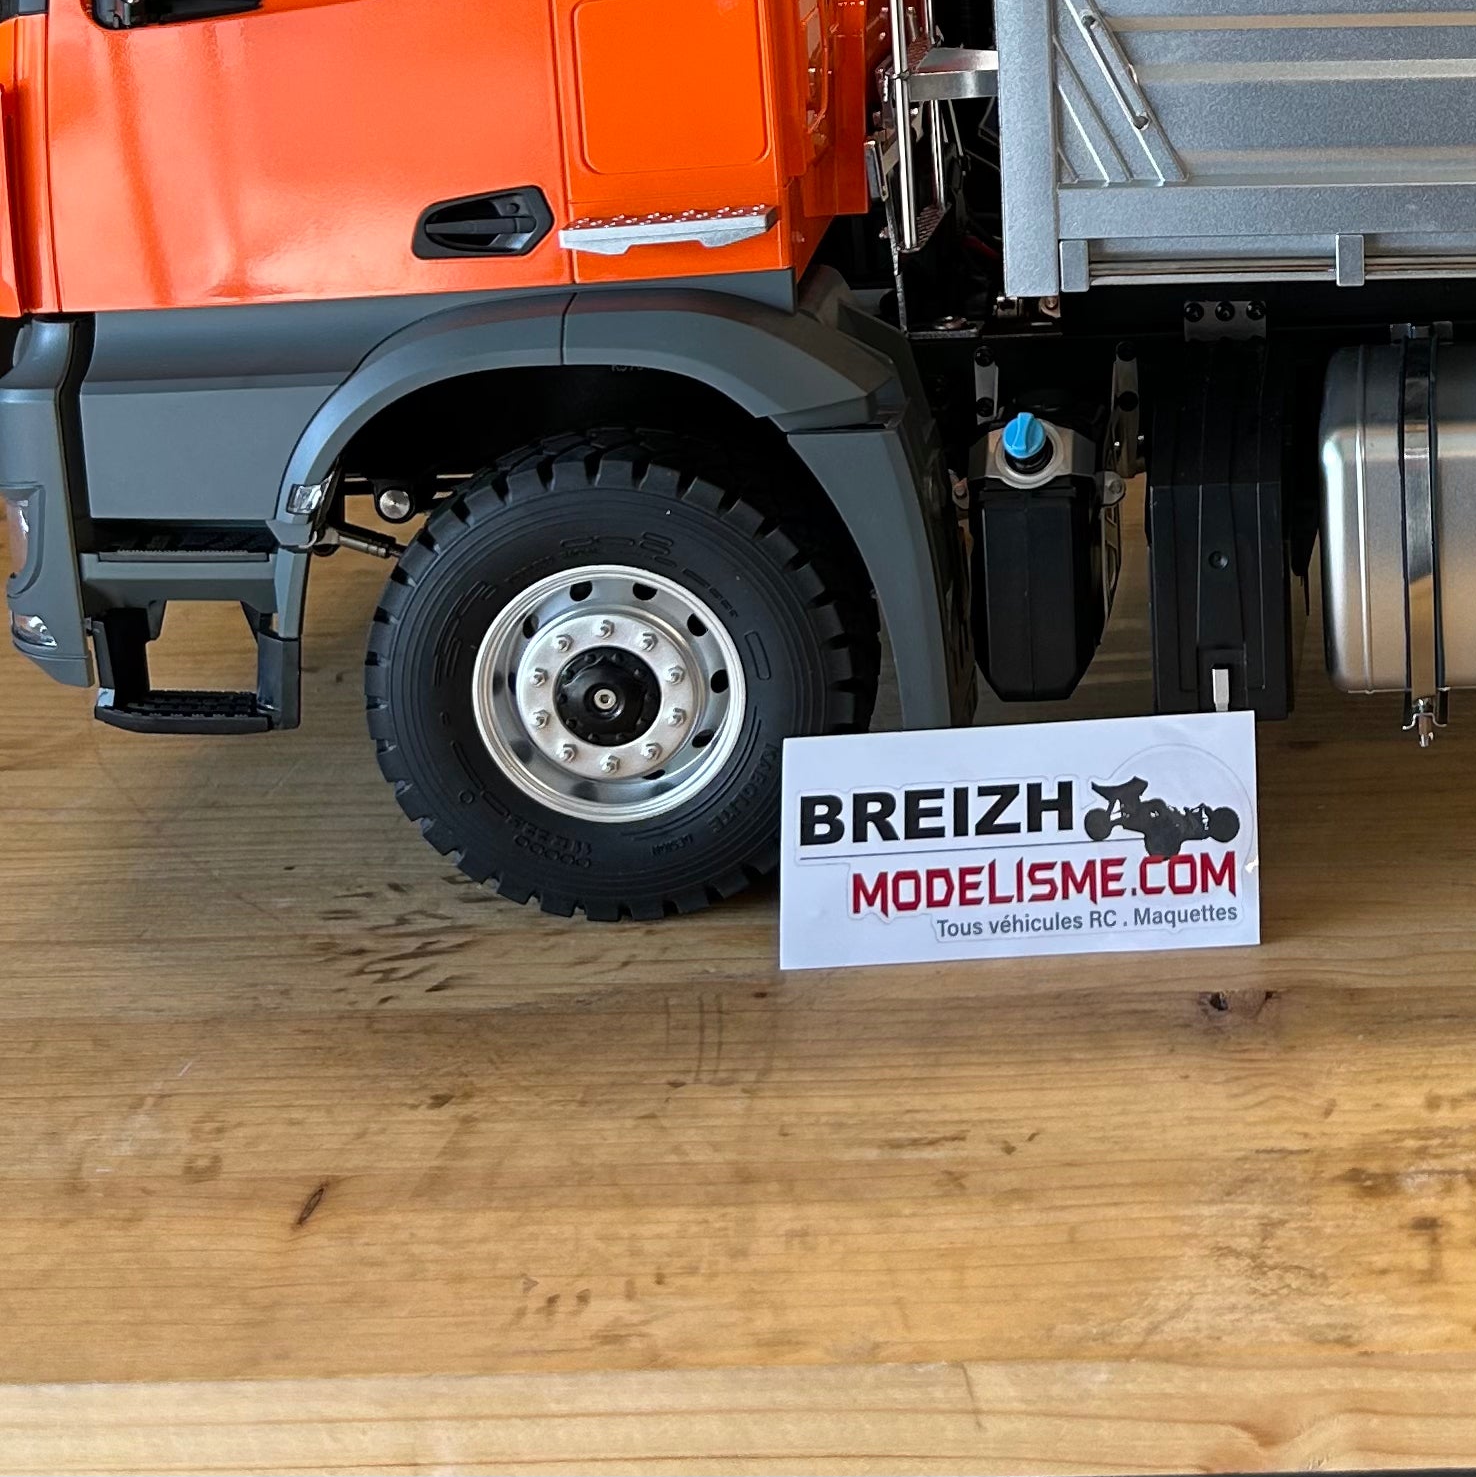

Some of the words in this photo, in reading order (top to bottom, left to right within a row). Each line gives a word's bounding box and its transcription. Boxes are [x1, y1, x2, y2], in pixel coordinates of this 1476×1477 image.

[799, 780, 1074, 846] BREIZH
[852, 851, 1237, 918] MODELISME.COM
[936, 918, 983, 937] Tous
[989, 911, 1084, 934] véhicules
[1088, 909, 1117, 928] RC
[1133, 903, 1238, 929] Maquettes
